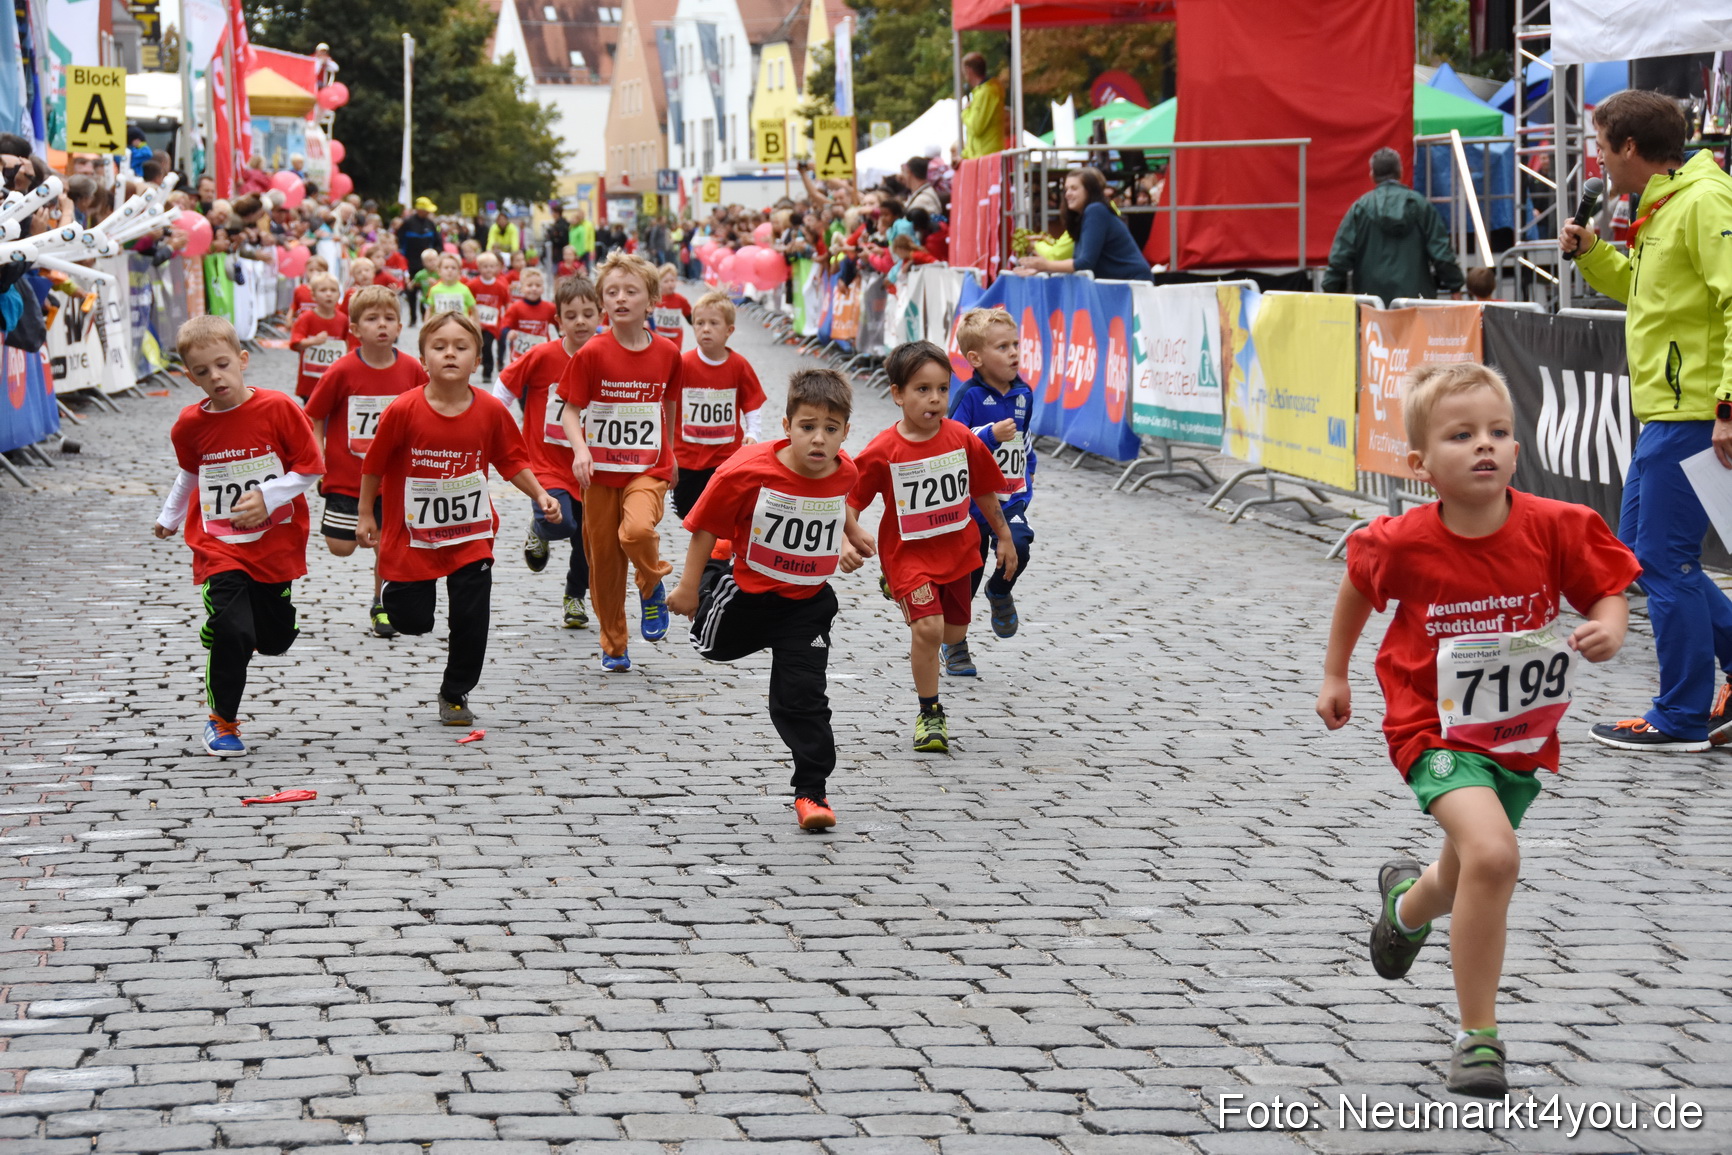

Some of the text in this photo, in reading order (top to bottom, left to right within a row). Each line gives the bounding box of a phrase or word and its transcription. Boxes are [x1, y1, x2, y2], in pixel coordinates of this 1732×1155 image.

[74, 69, 120, 86] Block
[80, 94, 113, 135] A
[819, 118, 851, 130] Block
[766, 133, 780, 154] B
[825, 135, 848, 165] A
[706, 183, 717, 198] C
[310, 347, 342, 363] 7033
[601, 379, 651, 389] Neumarkter
[600, 389, 640, 400] Stadtlauf
[617, 405, 654, 415] BOCK
[689, 402, 733, 423] 7066
[593, 419, 655, 446] 7052
[411, 447, 463, 459] Neumarkter
[605, 451, 640, 464] Ludwig
[929, 452, 967, 470] BOCK
[232, 456, 276, 475] BOCK
[442, 474, 481, 491] BOCK
[902, 469, 968, 510] 7206
[414, 490, 482, 525] 7057
[766, 499, 797, 511] NeuerMarkt
[802, 499, 841, 512] BOCK
[927, 510, 960, 526] Timur
[764, 511, 837, 552] 7091
[773, 556, 817, 573] Patrick
[1426, 595, 1524, 617] Neumarkter
[1425, 614, 1505, 637] Stadtlauf
[1451, 649, 1501, 659] NeuerMarkt
[1456, 651, 1570, 717] 7199
[1567, 690, 1572, 699] K
[1447, 716, 1454, 725] 2
[1493, 722, 1528, 742] Tom
